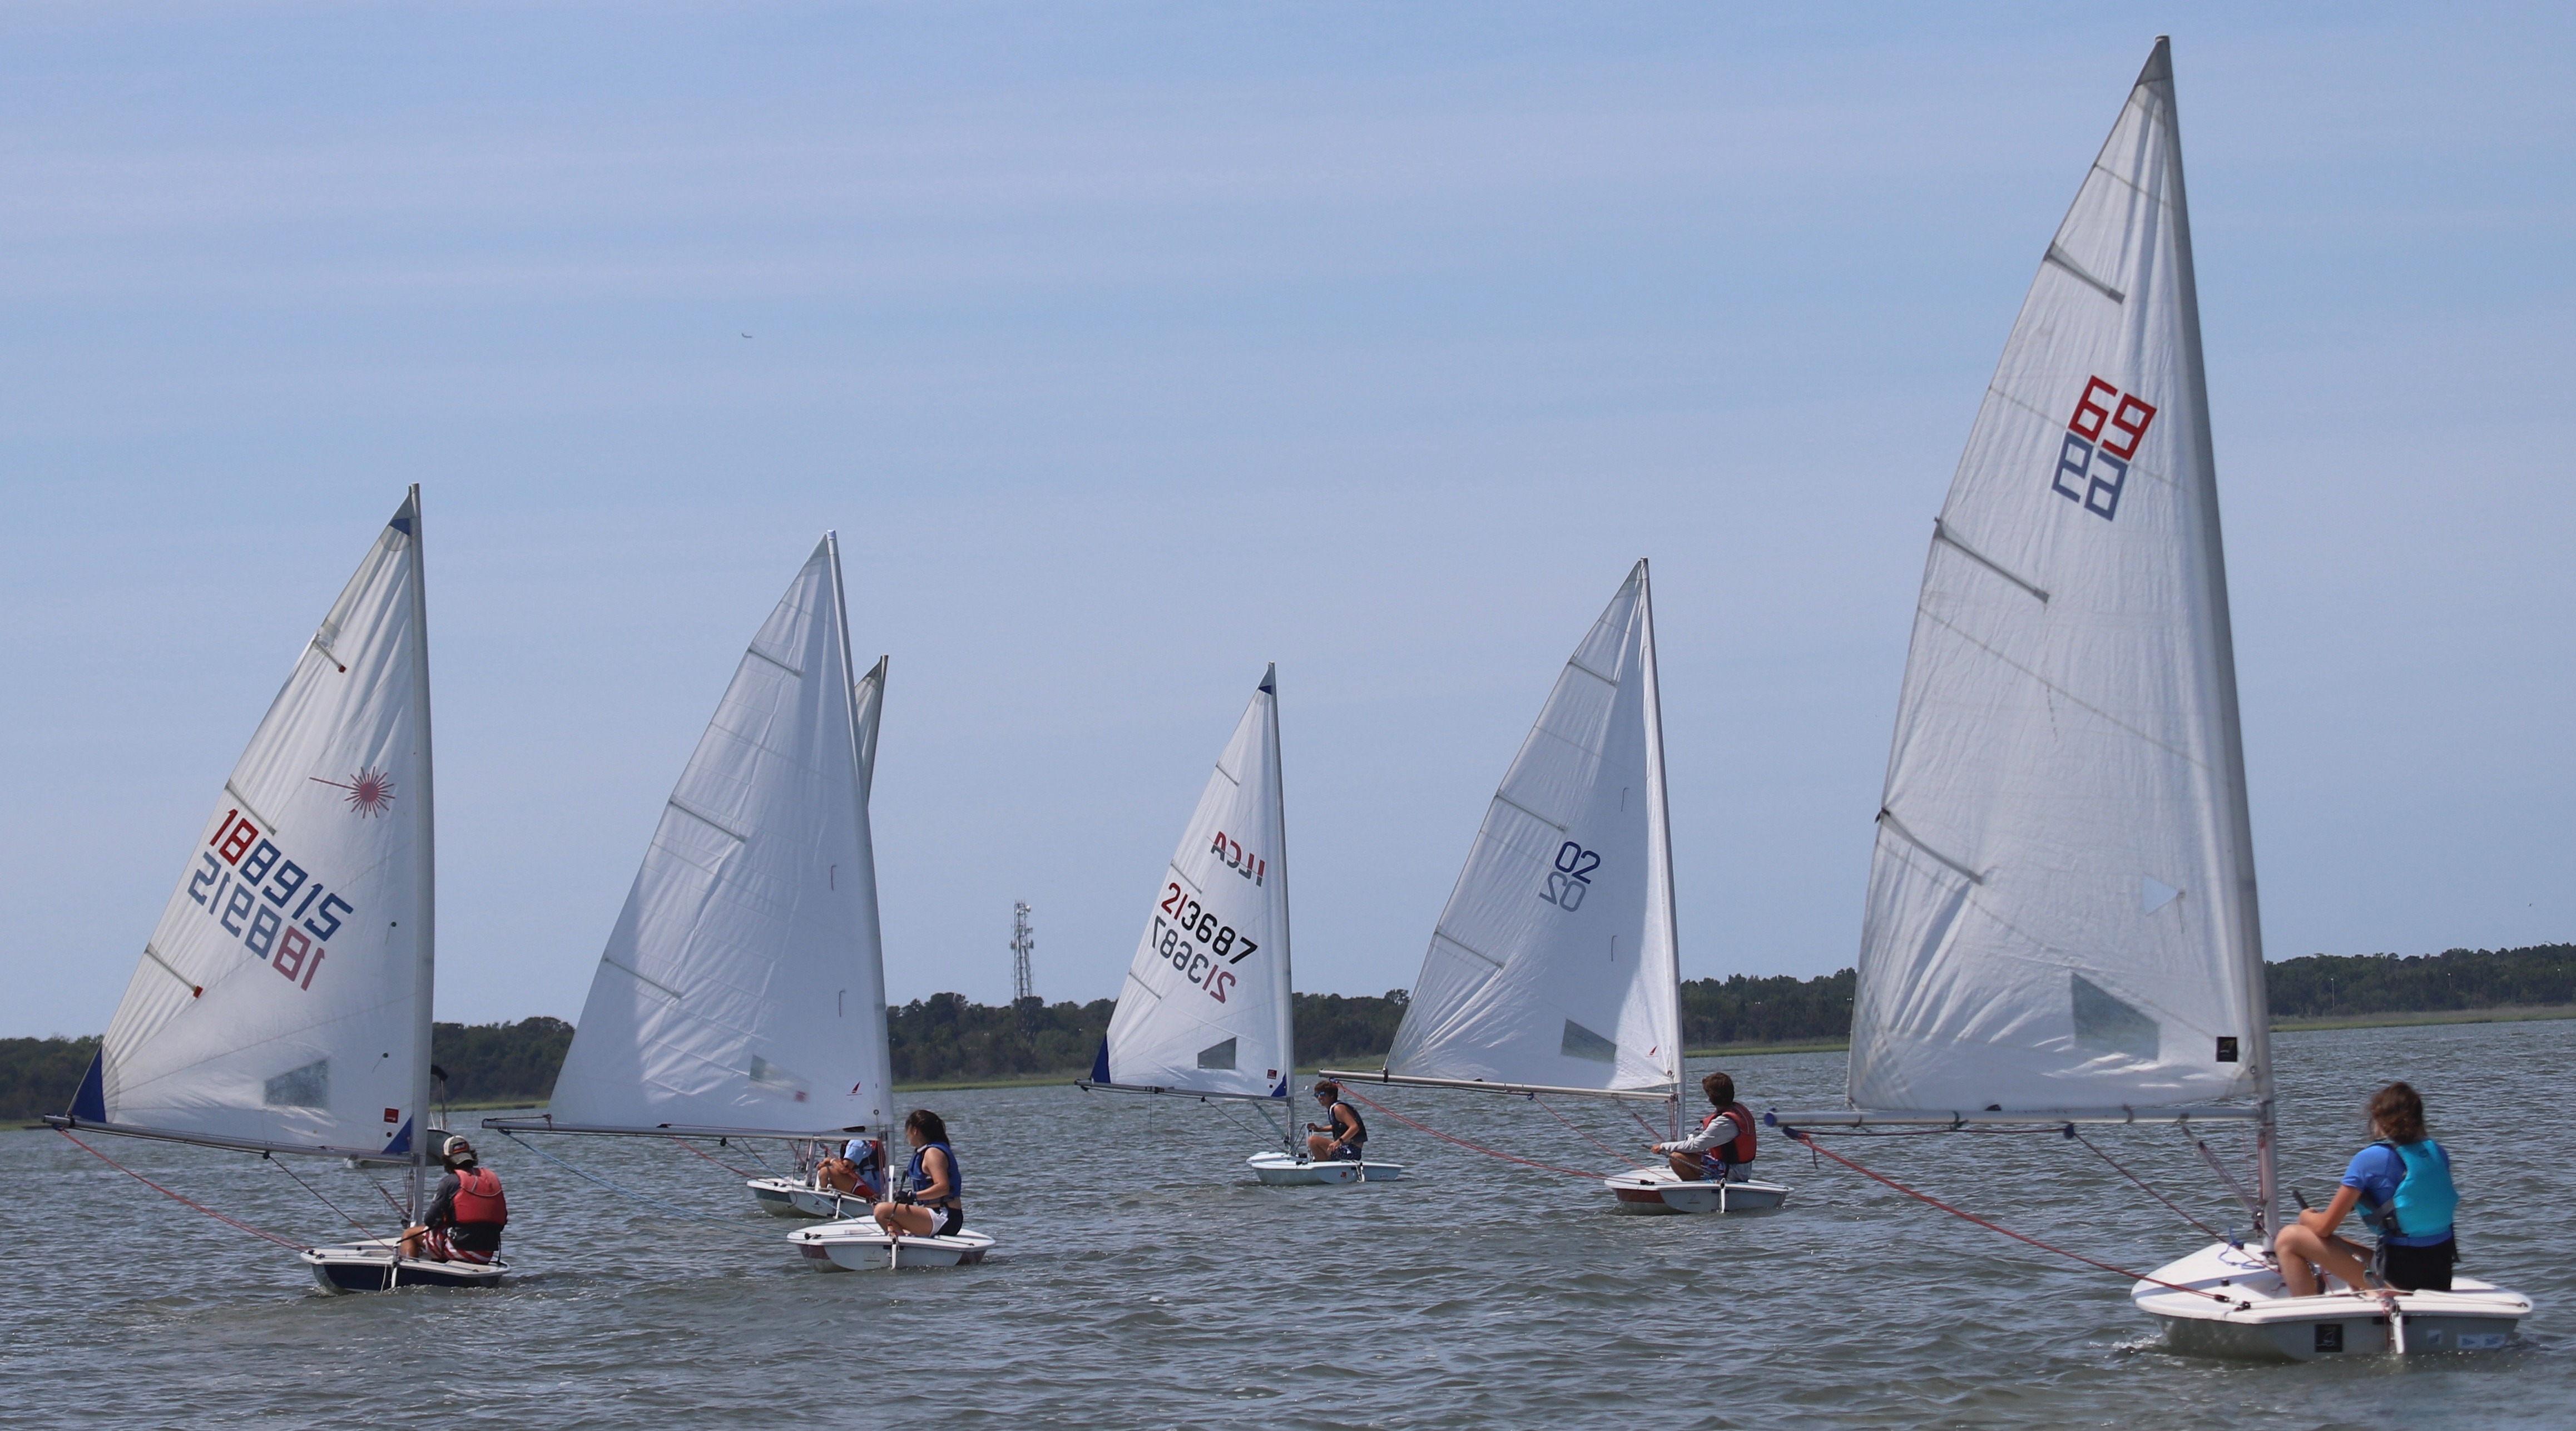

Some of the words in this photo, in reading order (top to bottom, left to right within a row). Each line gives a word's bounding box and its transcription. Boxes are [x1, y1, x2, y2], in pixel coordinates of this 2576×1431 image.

[2068, 375, 2157, 462] 69
[209, 809, 354, 942] 188915
[1555, 841, 1601, 884] 02
[1161, 882, 1258, 964] 213687
